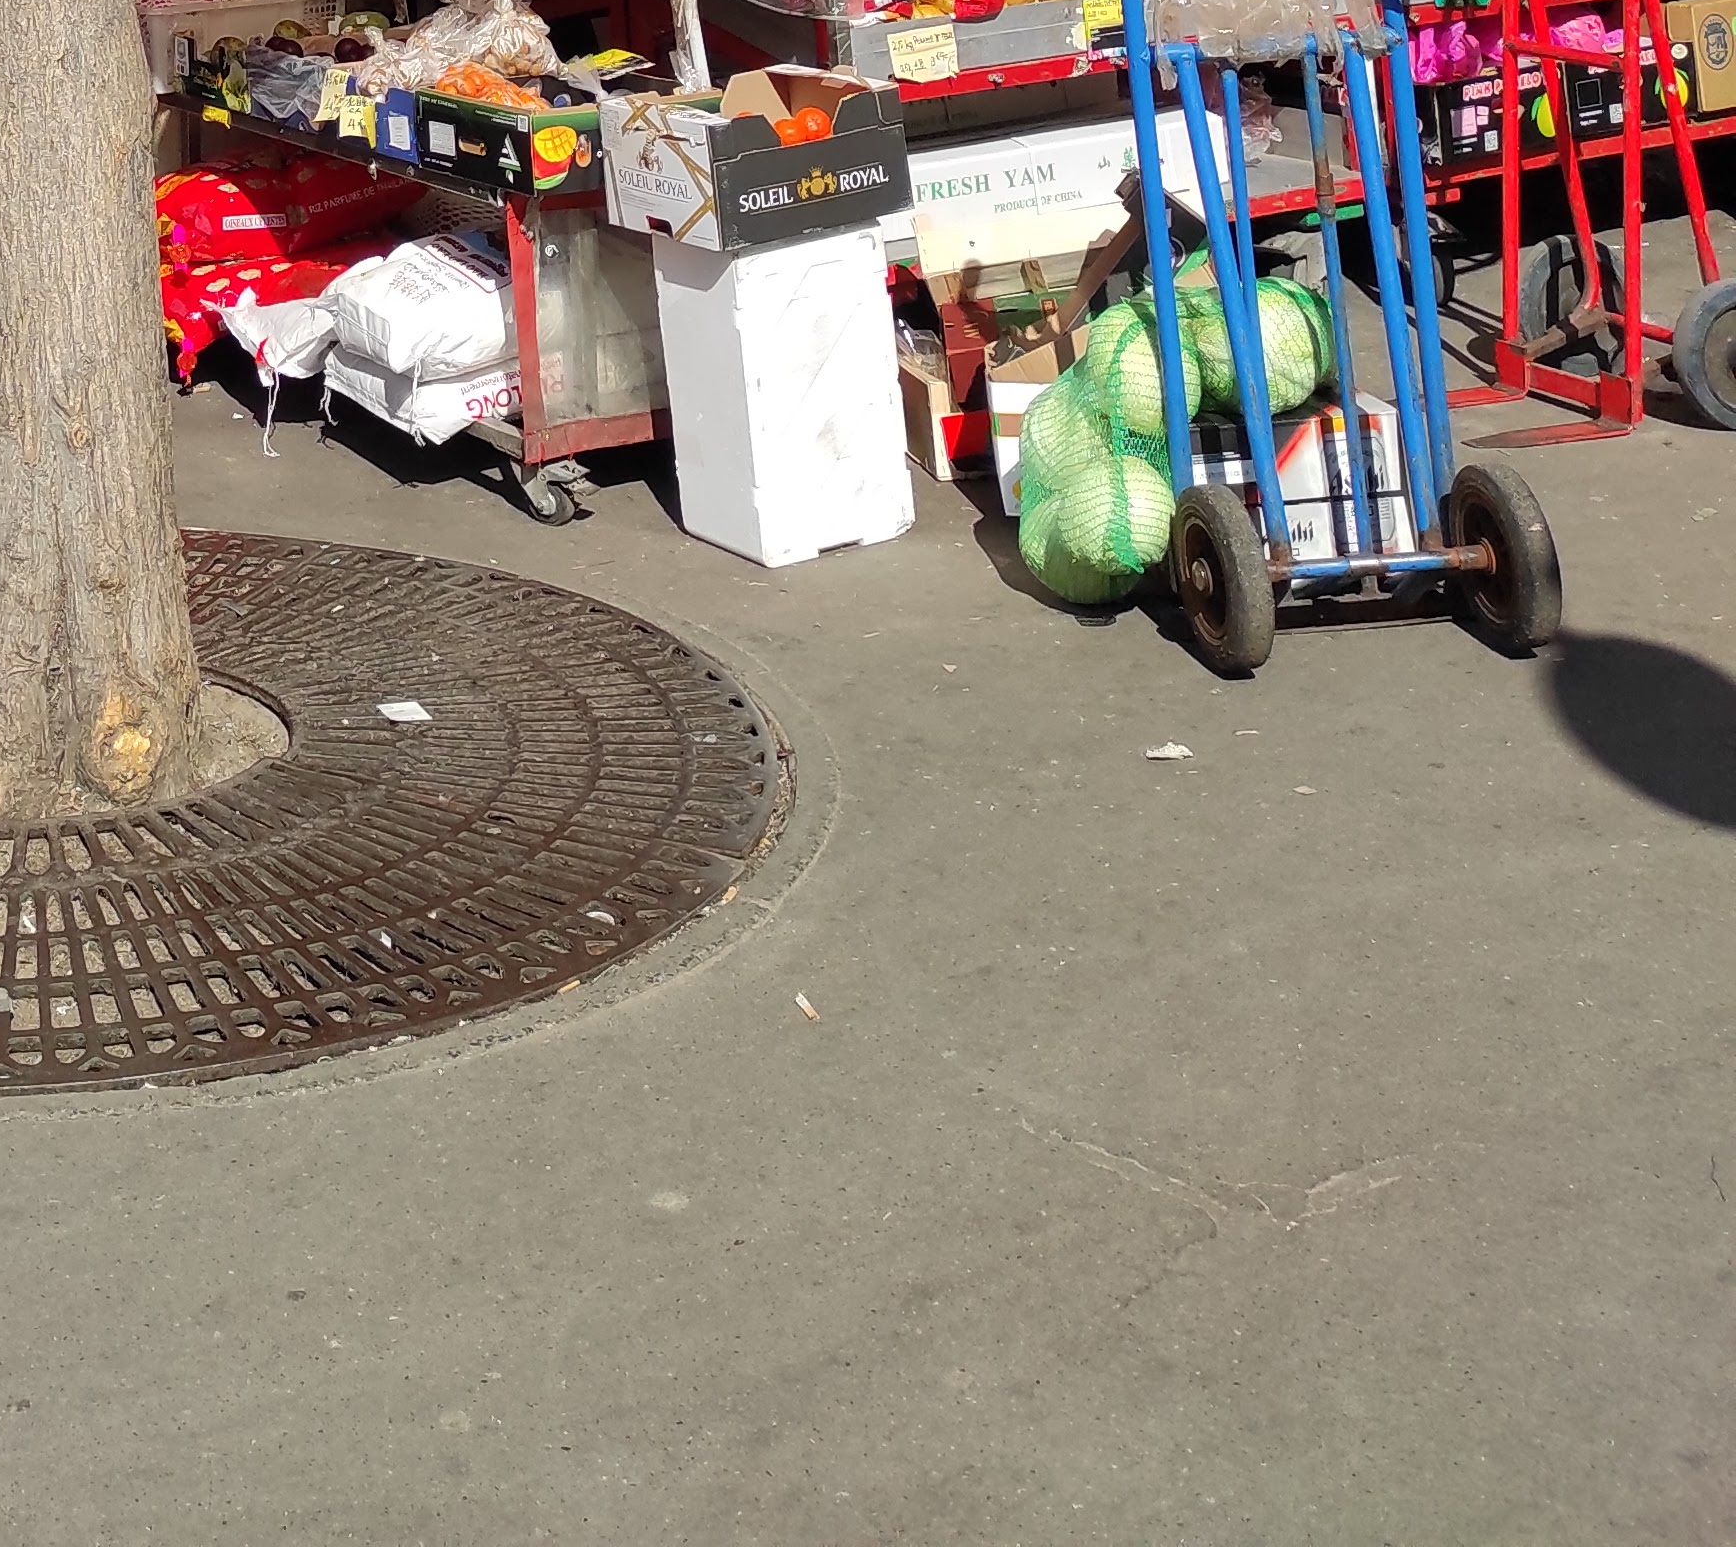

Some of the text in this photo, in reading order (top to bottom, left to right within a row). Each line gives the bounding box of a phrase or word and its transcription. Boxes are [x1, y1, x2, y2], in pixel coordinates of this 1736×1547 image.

[618, 168, 693, 200] SOLEIL ROYAL
[739, 163, 890, 213] SOLEIL ROYAL
[914, 162, 1057, 203] FRESH YAM
[994, 189, 1083, 214] PRODUCE OF CHINA
[465, 385, 523, 419] LONG
